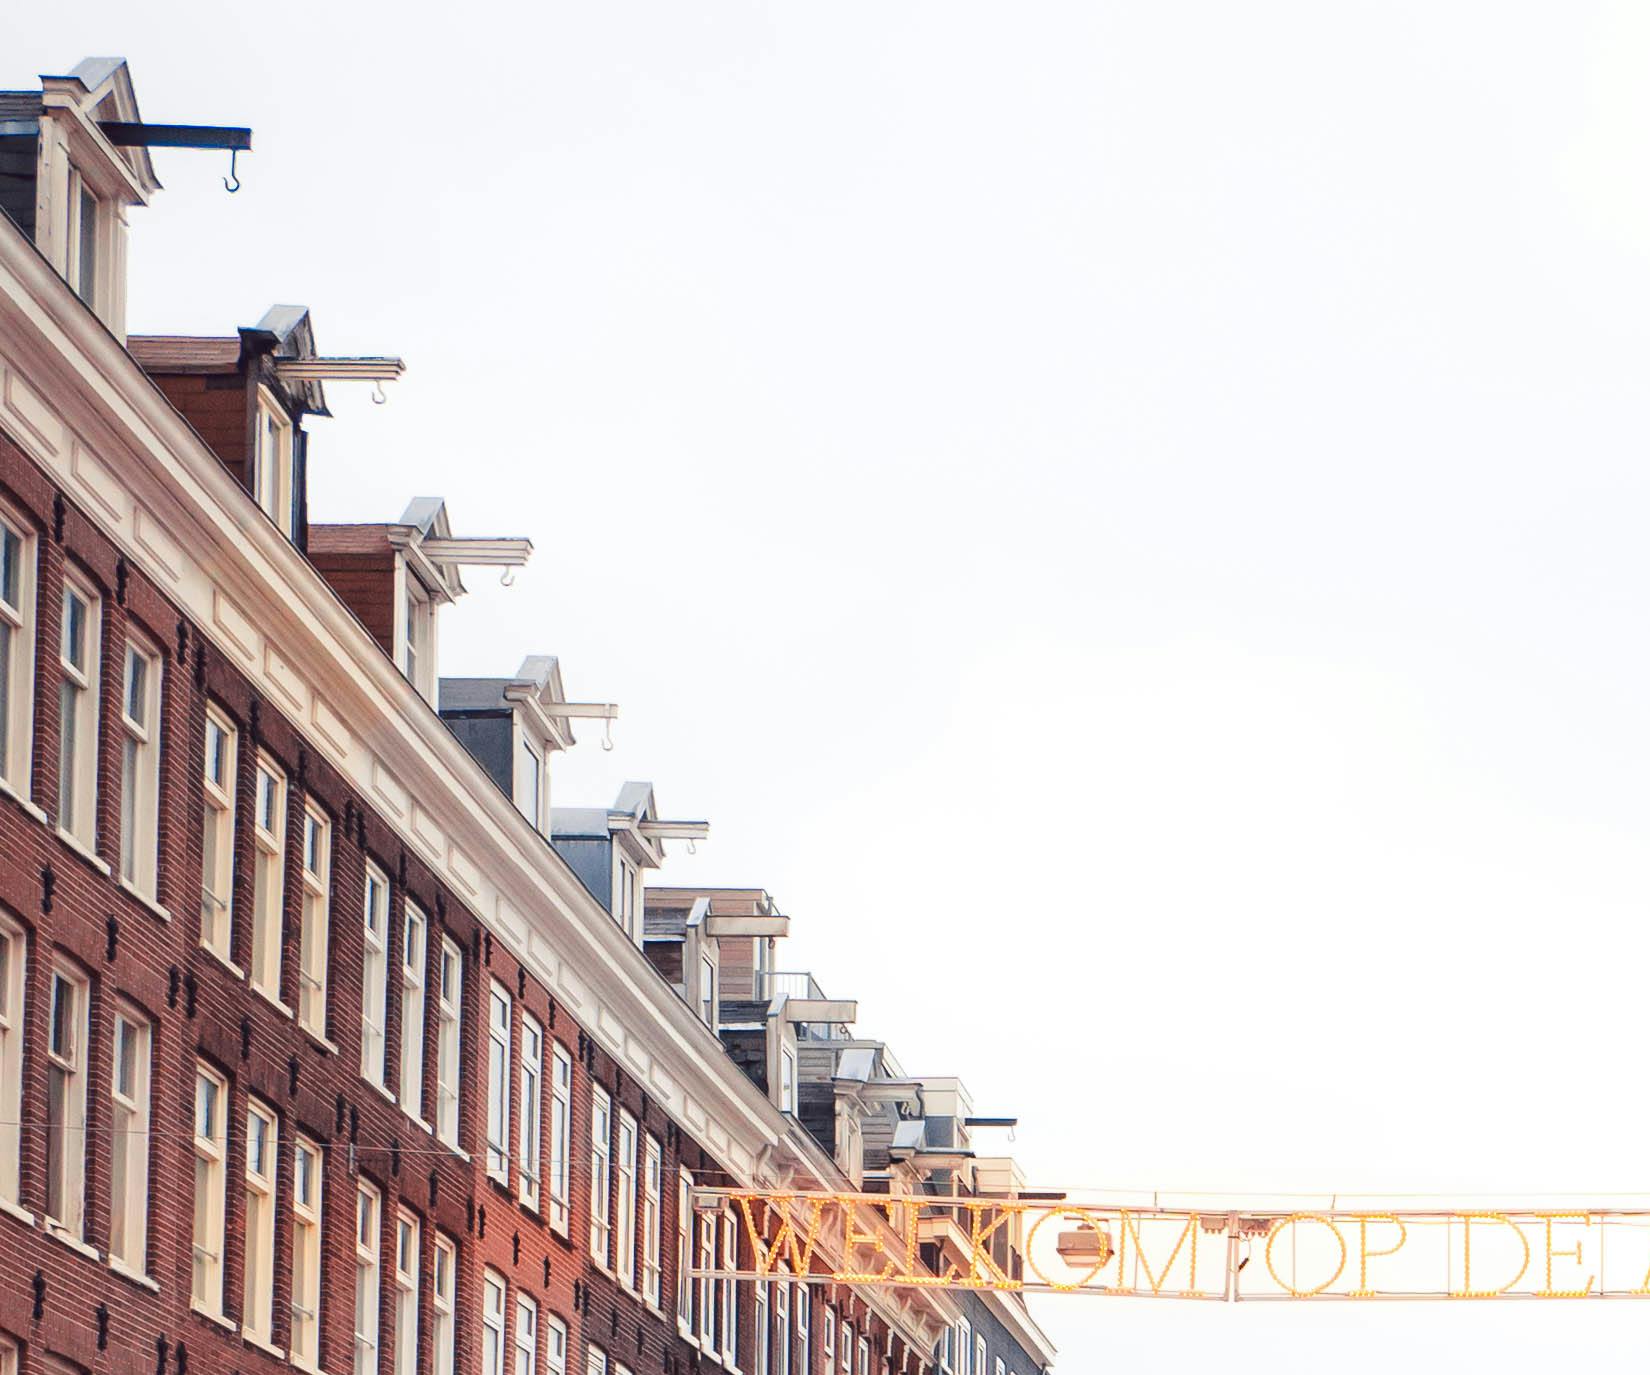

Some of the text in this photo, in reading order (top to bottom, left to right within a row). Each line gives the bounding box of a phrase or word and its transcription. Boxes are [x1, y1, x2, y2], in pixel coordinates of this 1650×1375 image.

[731, 1192, 1204, 1296] WELKOM
[1265, 1210, 1407, 1298] OP
[1448, 1209, 1596, 1298] DE
